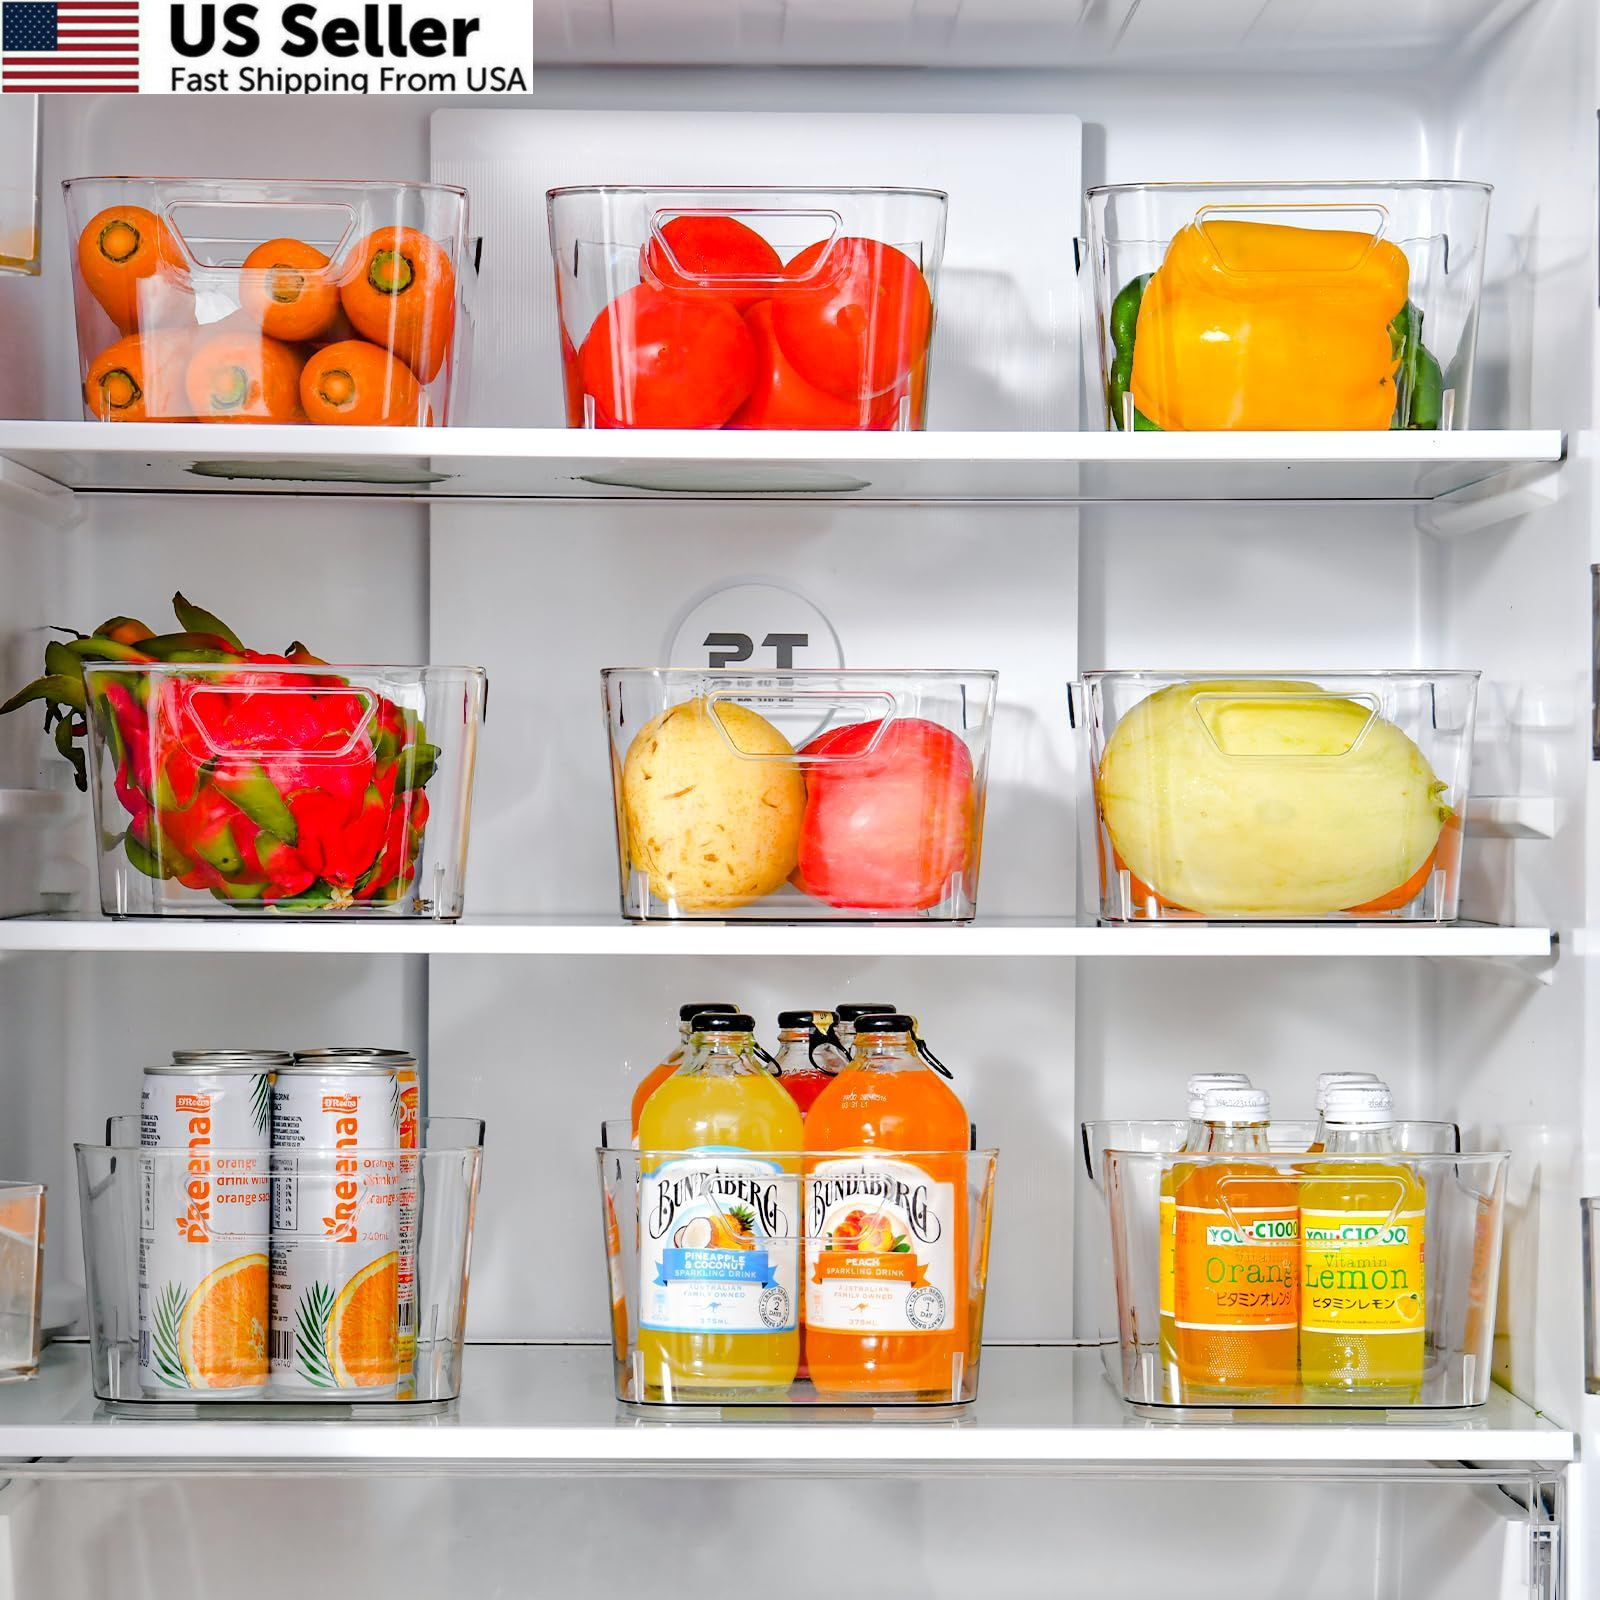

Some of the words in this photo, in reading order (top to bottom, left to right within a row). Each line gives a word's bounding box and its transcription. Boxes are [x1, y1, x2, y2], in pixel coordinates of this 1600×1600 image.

[702, 632, 808, 679] PT
[217, 1158, 257, 1171] orange
[217, 1193, 256, 1206] orange
[684, 1251, 746, 1263] PINEAPPLE
[845, 1257, 881, 1267] PEACH
[1323, 1254, 1388, 1268] Vitamin
[684, 1261, 692, 1269] &
[694, 1260, 745, 1270] COCONUT
[674, 1268, 725, 1278] SPARKLING
[728, 1270, 757, 1279] DRINK
[826, 1267, 873, 1276] SPARKLING
[875, 1268, 905, 1278] DRINK
[1305, 1264, 1409, 1290] Lemon
[714, 1291, 747, 1299] OWNED
[773, 1301, 780, 1311] 2
[1312, 1297, 1396, 1310] ビタミンレモン
[919, 1310, 934, 1319] DAY
